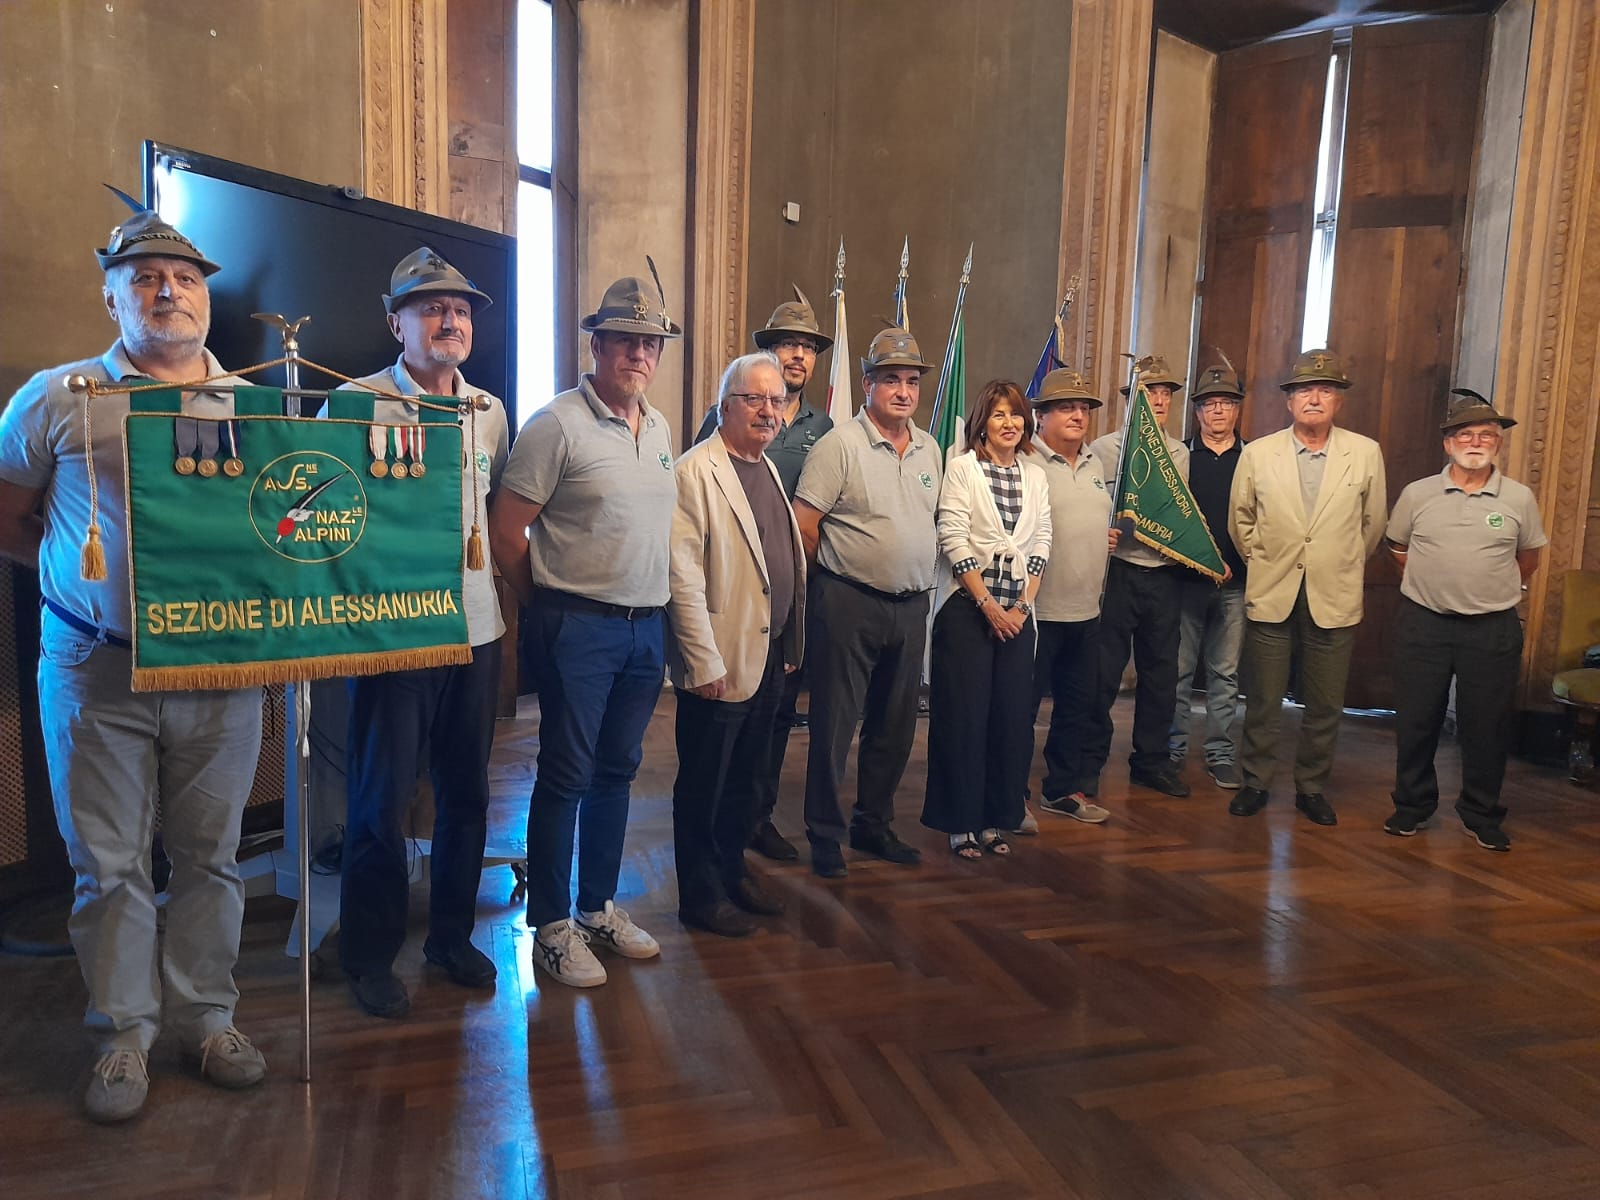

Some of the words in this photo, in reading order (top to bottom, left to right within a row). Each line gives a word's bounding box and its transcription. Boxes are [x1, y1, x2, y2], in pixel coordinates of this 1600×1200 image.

[1151, 446, 1165, 459] DI
[1157, 457, 1193, 520] ALESSANDRIA
[294, 527, 351, 542] ALPINI
[147, 599, 263, 635] SEZIONE
[270, 598, 294, 628] DI
[300, 589, 458, 626] ALESSANDRIA
